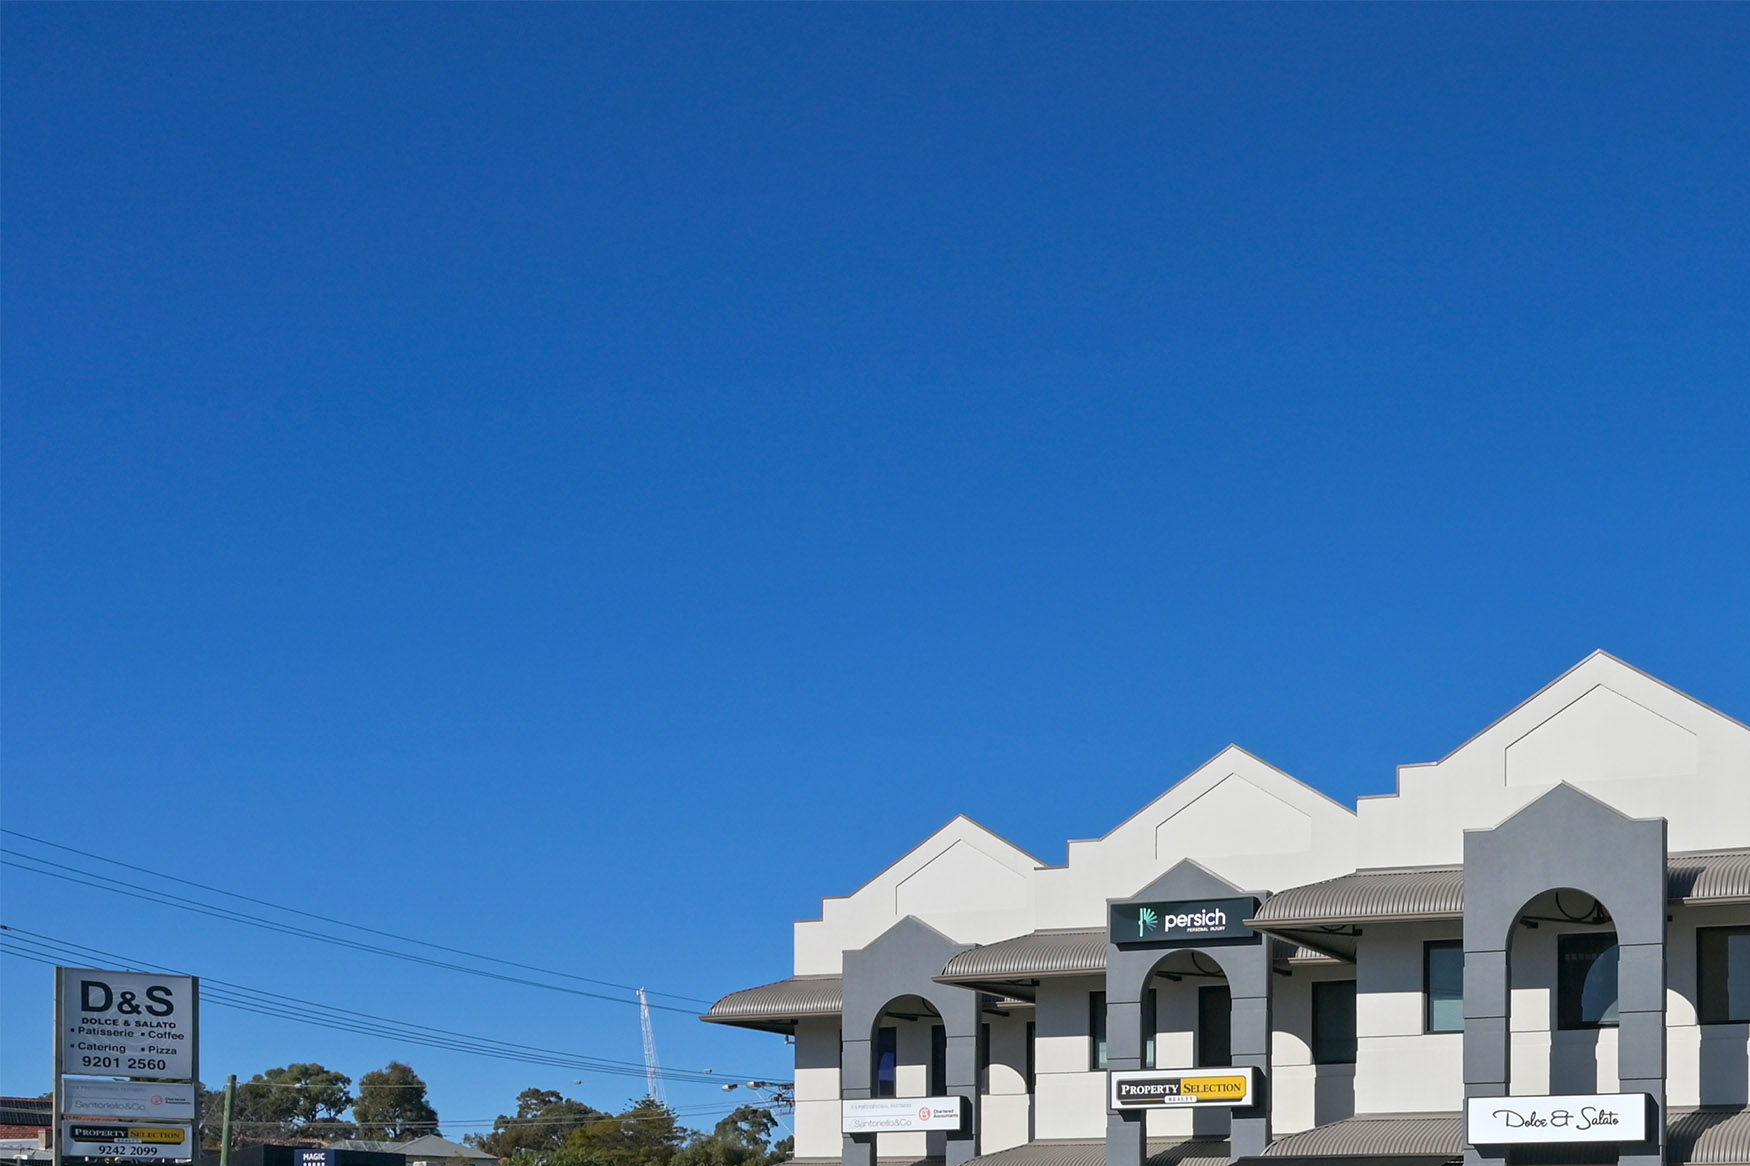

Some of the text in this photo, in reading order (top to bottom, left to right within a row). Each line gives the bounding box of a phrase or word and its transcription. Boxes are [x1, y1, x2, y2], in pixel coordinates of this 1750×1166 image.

[1165, 908, 1226, 932] persich
[81, 980, 174, 1017] D&S
[81, 1017, 119, 1026] DOLCE
[135, 1020, 176, 1029] SALATO
[78, 1027, 185, 1040] Patisserie Coffee
[78, 1042, 177, 1055] Catering Pizza
[82, 1056, 166, 1070] 9201 2560
[1121, 1083, 1241, 1095] PROPERTY SELECTION
[1492, 1109, 1548, 1128] Dolce
[1576, 1106, 1619, 1130] Salato
[75, 1128, 127, 1137] PROPERTY
[99, 1145, 158, 1156] 9242 2099
